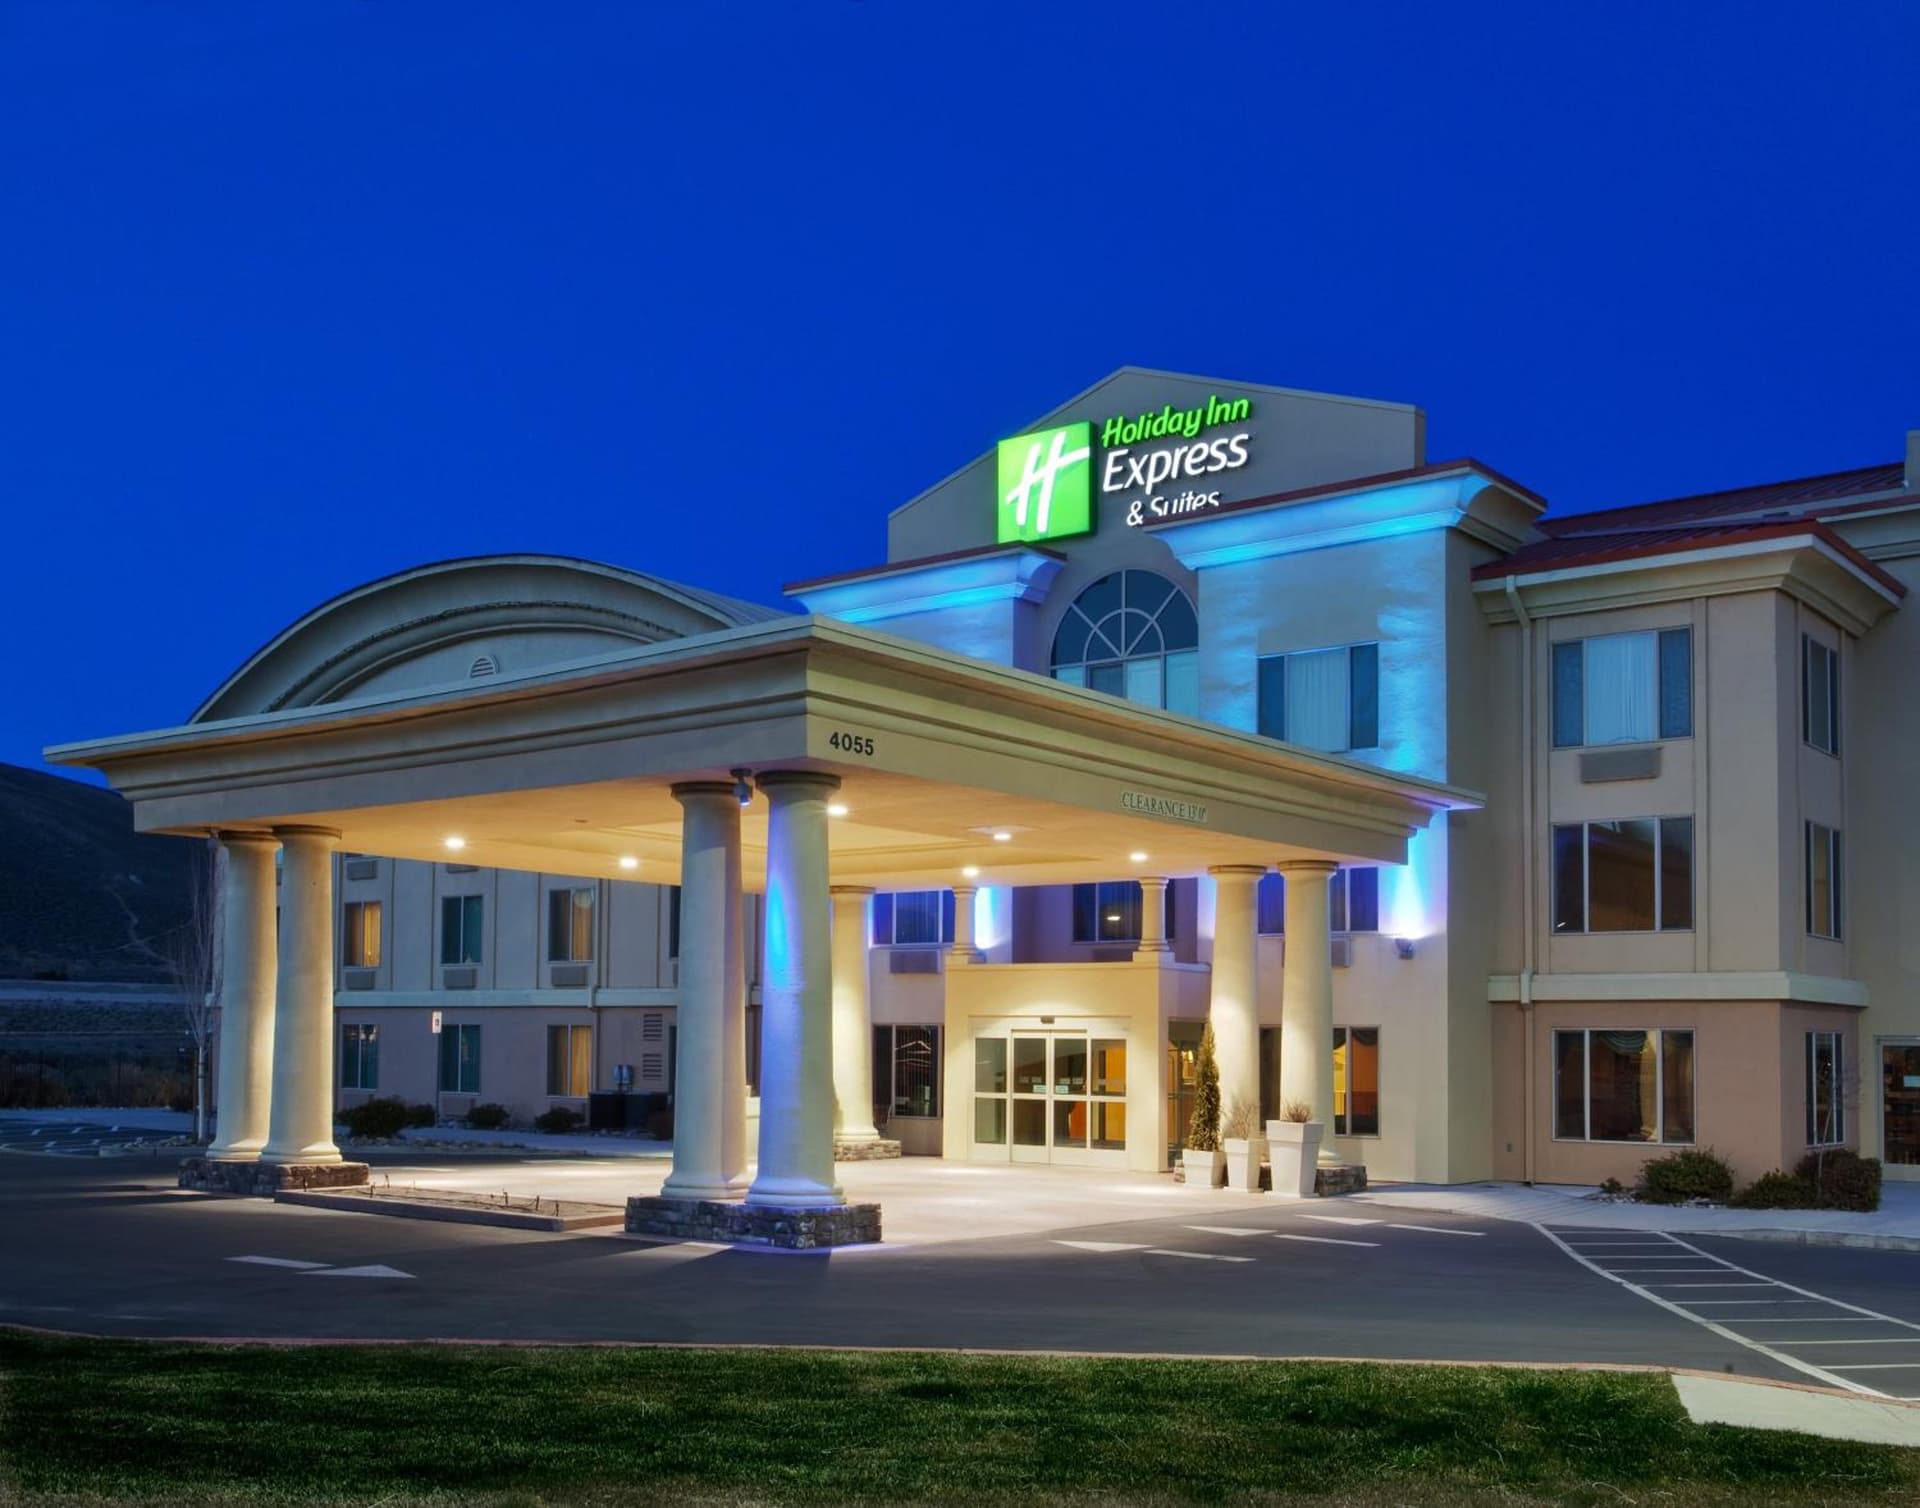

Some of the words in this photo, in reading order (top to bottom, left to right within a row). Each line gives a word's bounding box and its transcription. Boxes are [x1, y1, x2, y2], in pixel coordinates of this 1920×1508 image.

[1102, 405, 1201, 448] Holiday
[1206, 395, 1250, 426] Inn
[1006, 431, 1090, 533] H
[1103, 433, 1249, 495] Express
[1126, 500, 1144, 526] &
[1150, 490, 1220, 517] Suites
[829, 731, 874, 756] 4055
[1122, 791, 1185, 817] CLEARANCE
